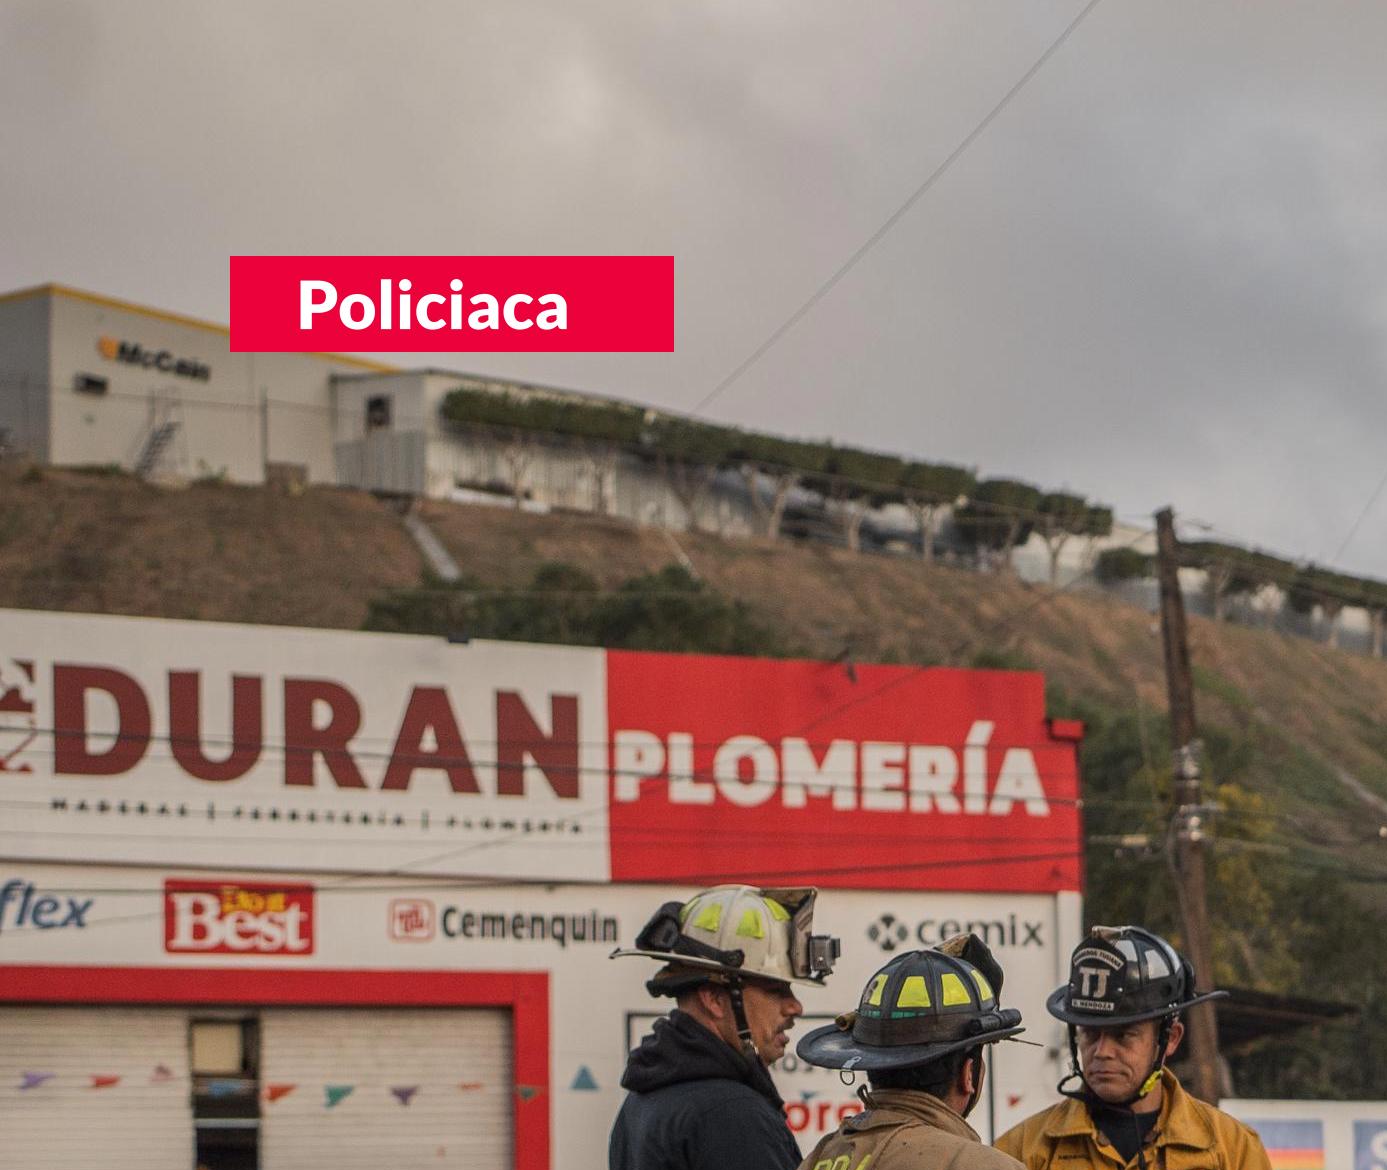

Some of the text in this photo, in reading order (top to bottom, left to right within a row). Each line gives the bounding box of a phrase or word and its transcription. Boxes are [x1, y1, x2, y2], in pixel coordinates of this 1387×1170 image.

[53, 663, 580, 798] DURAN
[614, 720, 1050, 816] PLOMERÍA
[167, 892, 310, 951] Best
[442, 907, 619, 949] Cemenquin
[916, 914, 1044, 947] cemix
[1079, 966, 1111, 998] TJ
